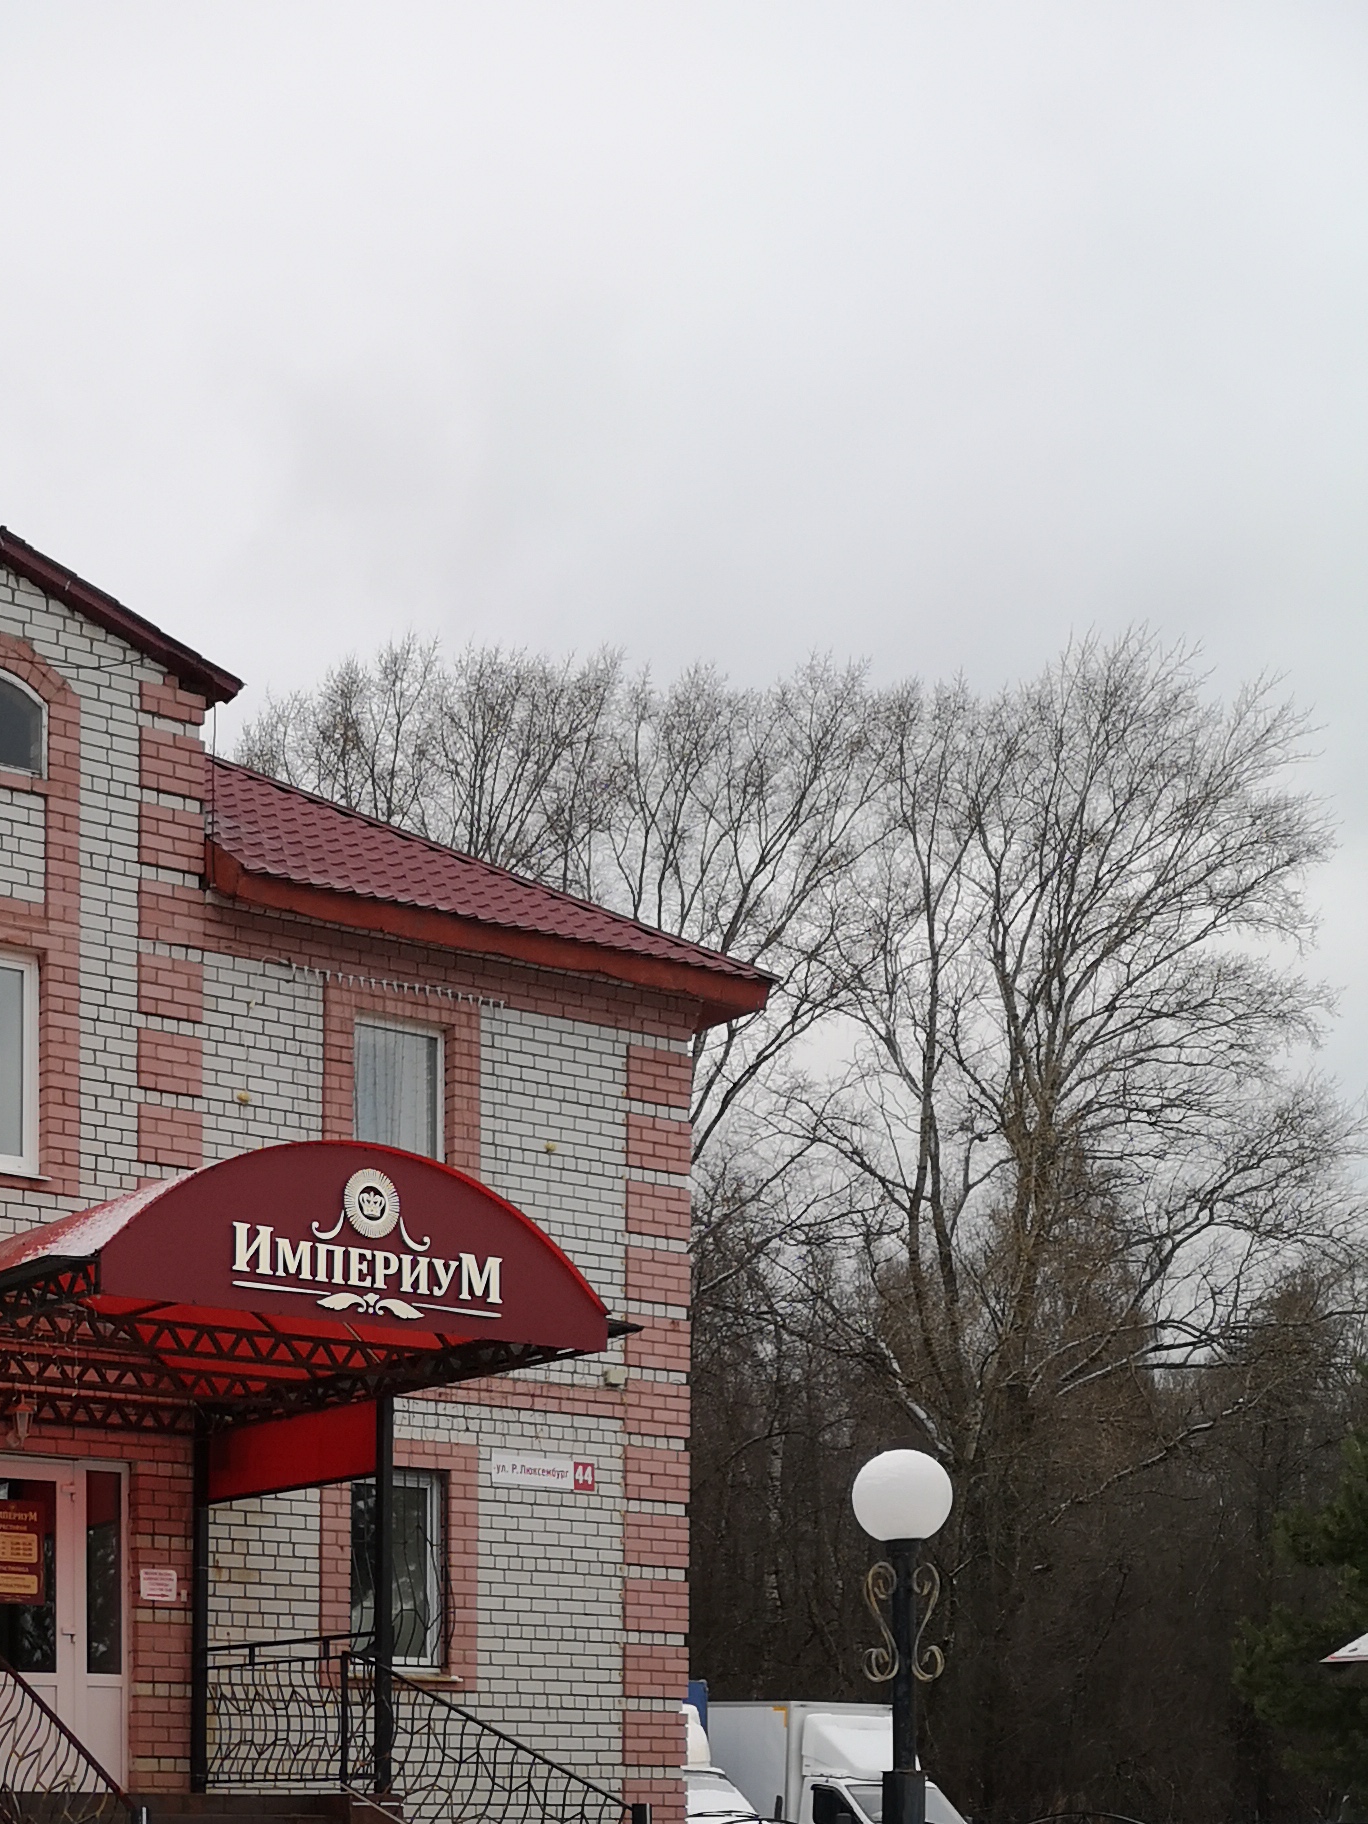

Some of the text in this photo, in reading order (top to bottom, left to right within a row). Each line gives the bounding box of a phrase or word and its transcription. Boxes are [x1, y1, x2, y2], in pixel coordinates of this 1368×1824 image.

[231, 1220, 503, 1304] ИМПЕРИУМ
[496, 1464, 509, 1474] ул.
[575, 1465, 593, 1485] 44
